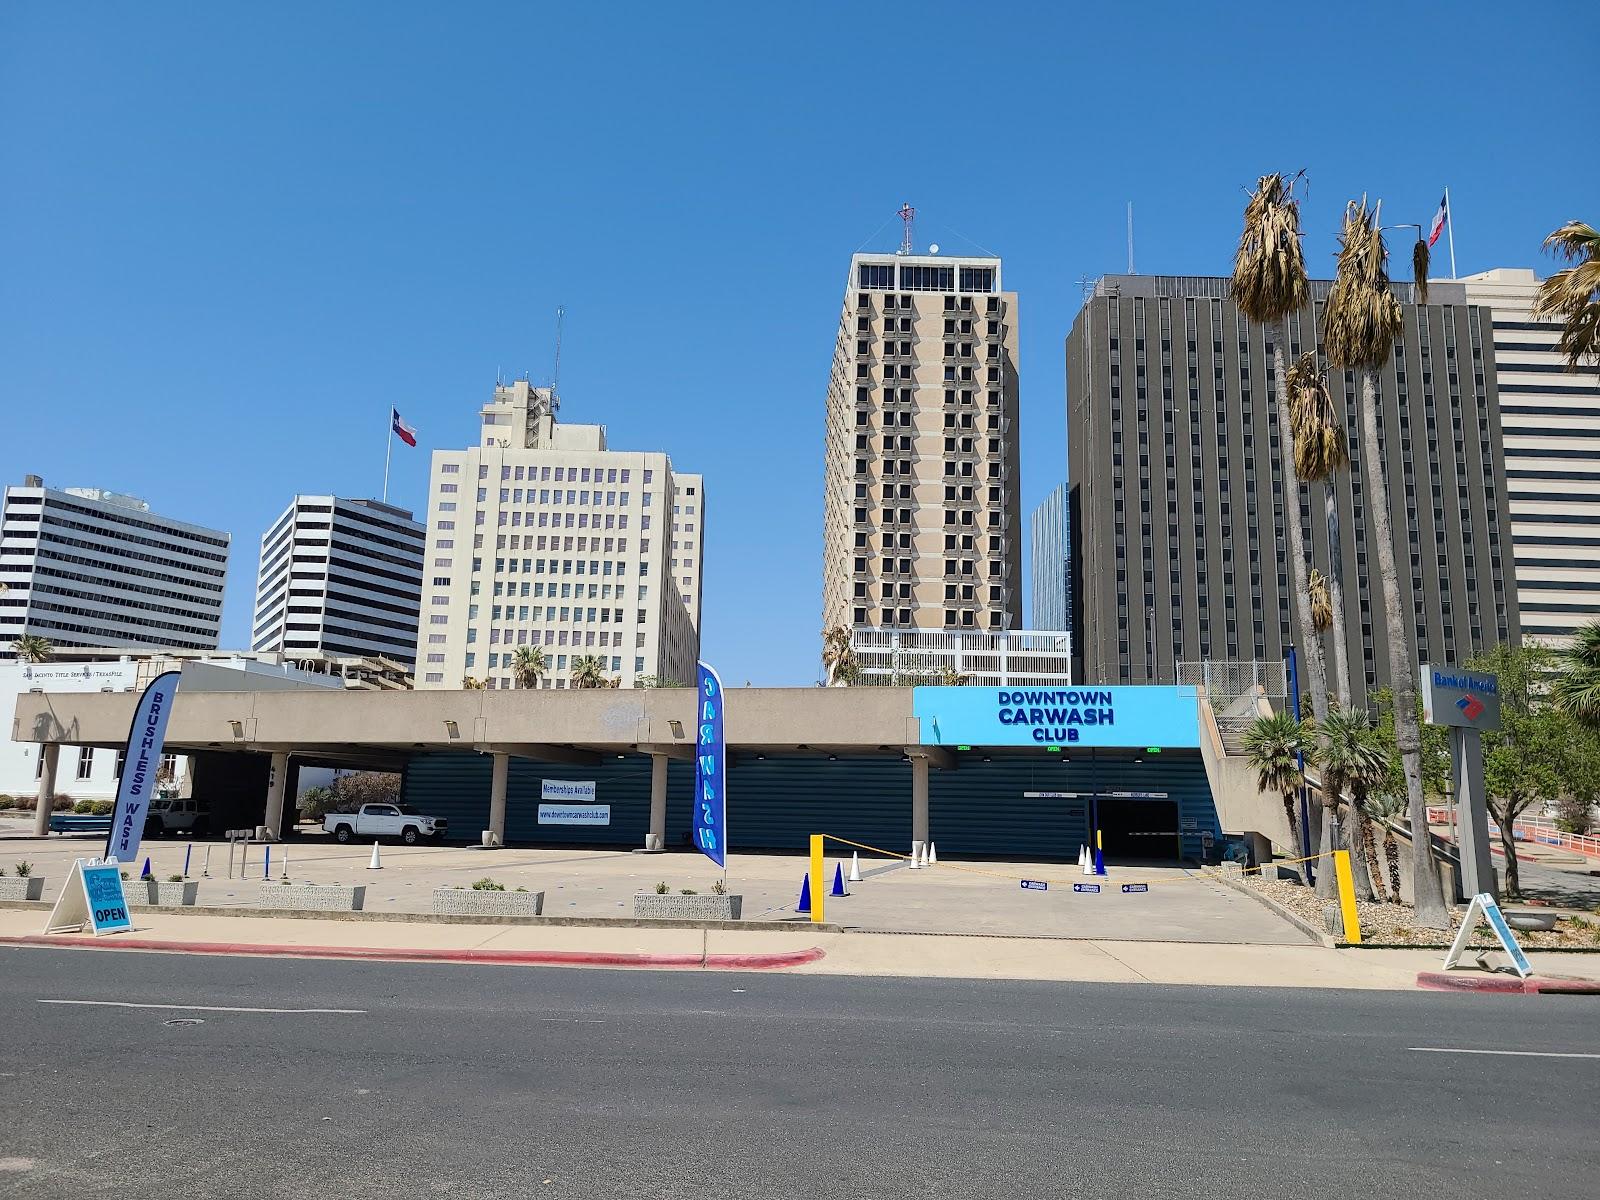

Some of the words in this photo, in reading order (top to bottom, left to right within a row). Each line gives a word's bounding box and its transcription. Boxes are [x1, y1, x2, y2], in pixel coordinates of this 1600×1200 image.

[1434, 671, 1457, 688] Bank
[1457, 675, 1467, 688] of
[1468, 676, 1497, 693] America
[998, 691, 1113, 706] DOWNTOWN
[998, 708, 1115, 726] CARWASH
[130, 691, 164, 796] BRUSHLESS
[1032, 727, 1080, 743] CLUB
[543, 784, 573, 795] Memberships
[574, 785, 594, 795] Available
[119, 801, 141, 851] WASH
[95, 908, 125, 922] OPEN
